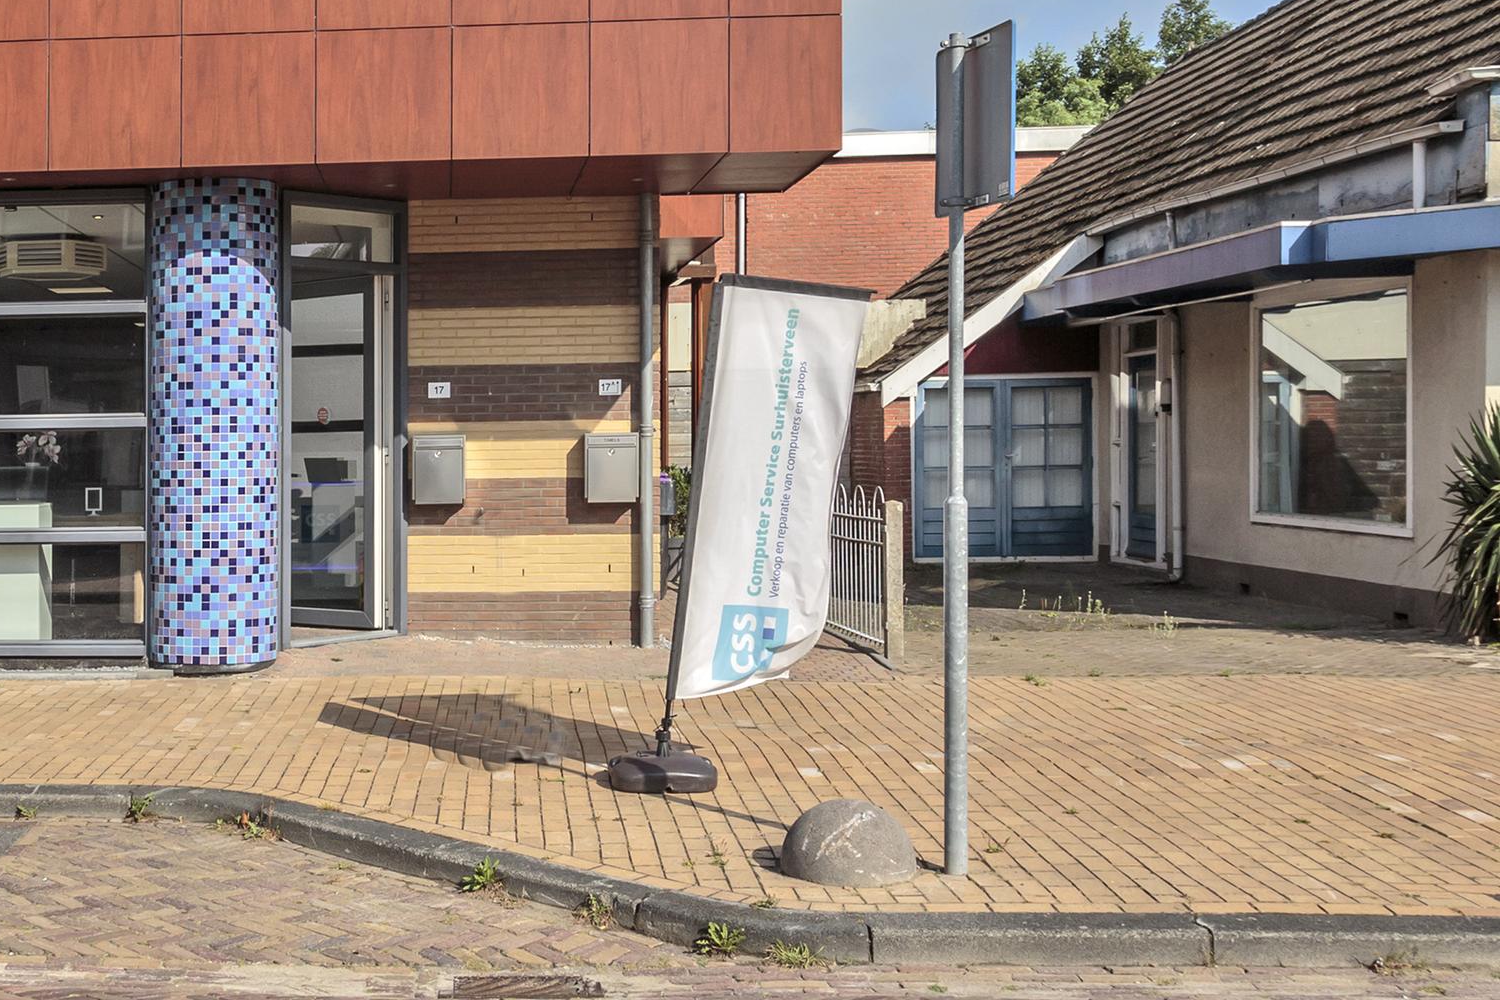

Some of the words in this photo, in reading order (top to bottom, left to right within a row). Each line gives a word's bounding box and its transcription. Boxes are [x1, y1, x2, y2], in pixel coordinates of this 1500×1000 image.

[434, 385, 445, 394] 17
[794, 361, 808, 399] laptops
[795, 401, 804, 414] en
[746, 511, 771, 597] Computer
[760, 444, 781, 507] Service
[771, 308, 800, 441] Surhuisterveen
[786, 415, 802, 471] computers
[783, 472, 793, 491] van
[777, 493, 791, 539] reparatie
[775, 541, 784, 554] en
[768, 555, 785, 598] Verkoop
[730, 612, 758, 674] CSS
